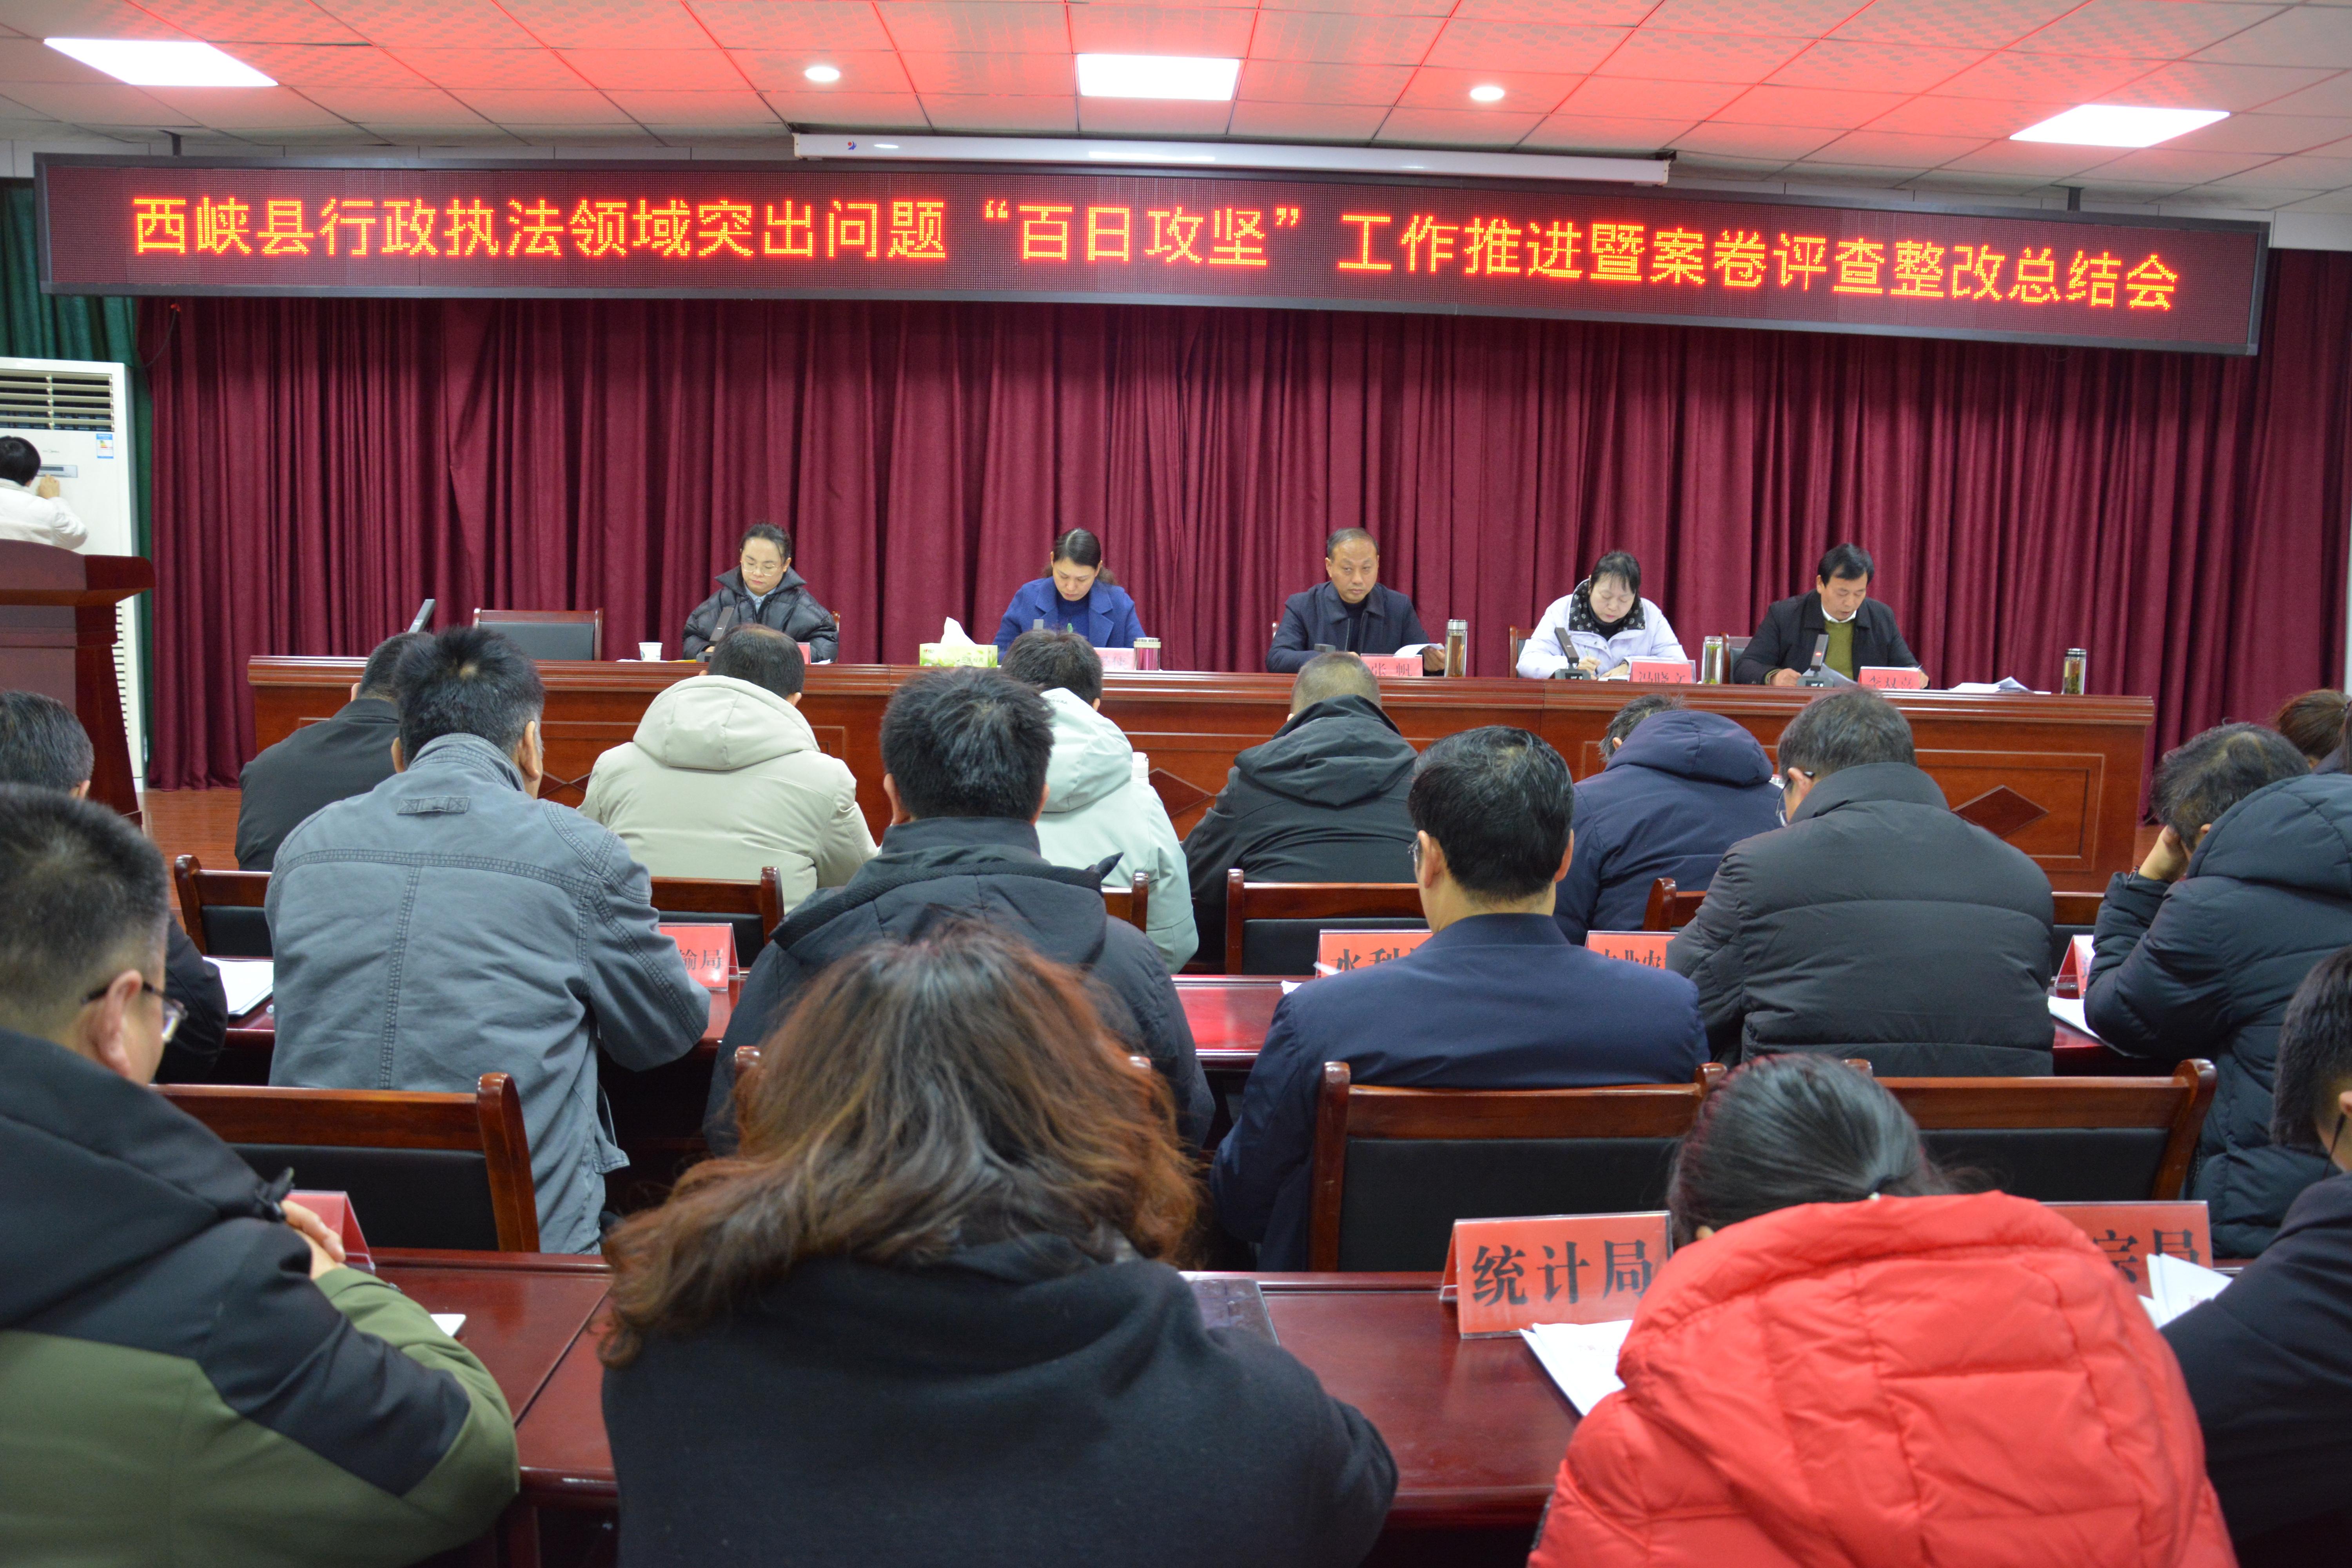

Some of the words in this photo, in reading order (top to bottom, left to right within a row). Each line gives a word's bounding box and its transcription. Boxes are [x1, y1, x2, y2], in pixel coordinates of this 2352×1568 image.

[1372, 662, 1412, 677] 张帆
[1472, 1240, 1653, 1307] 统计局
